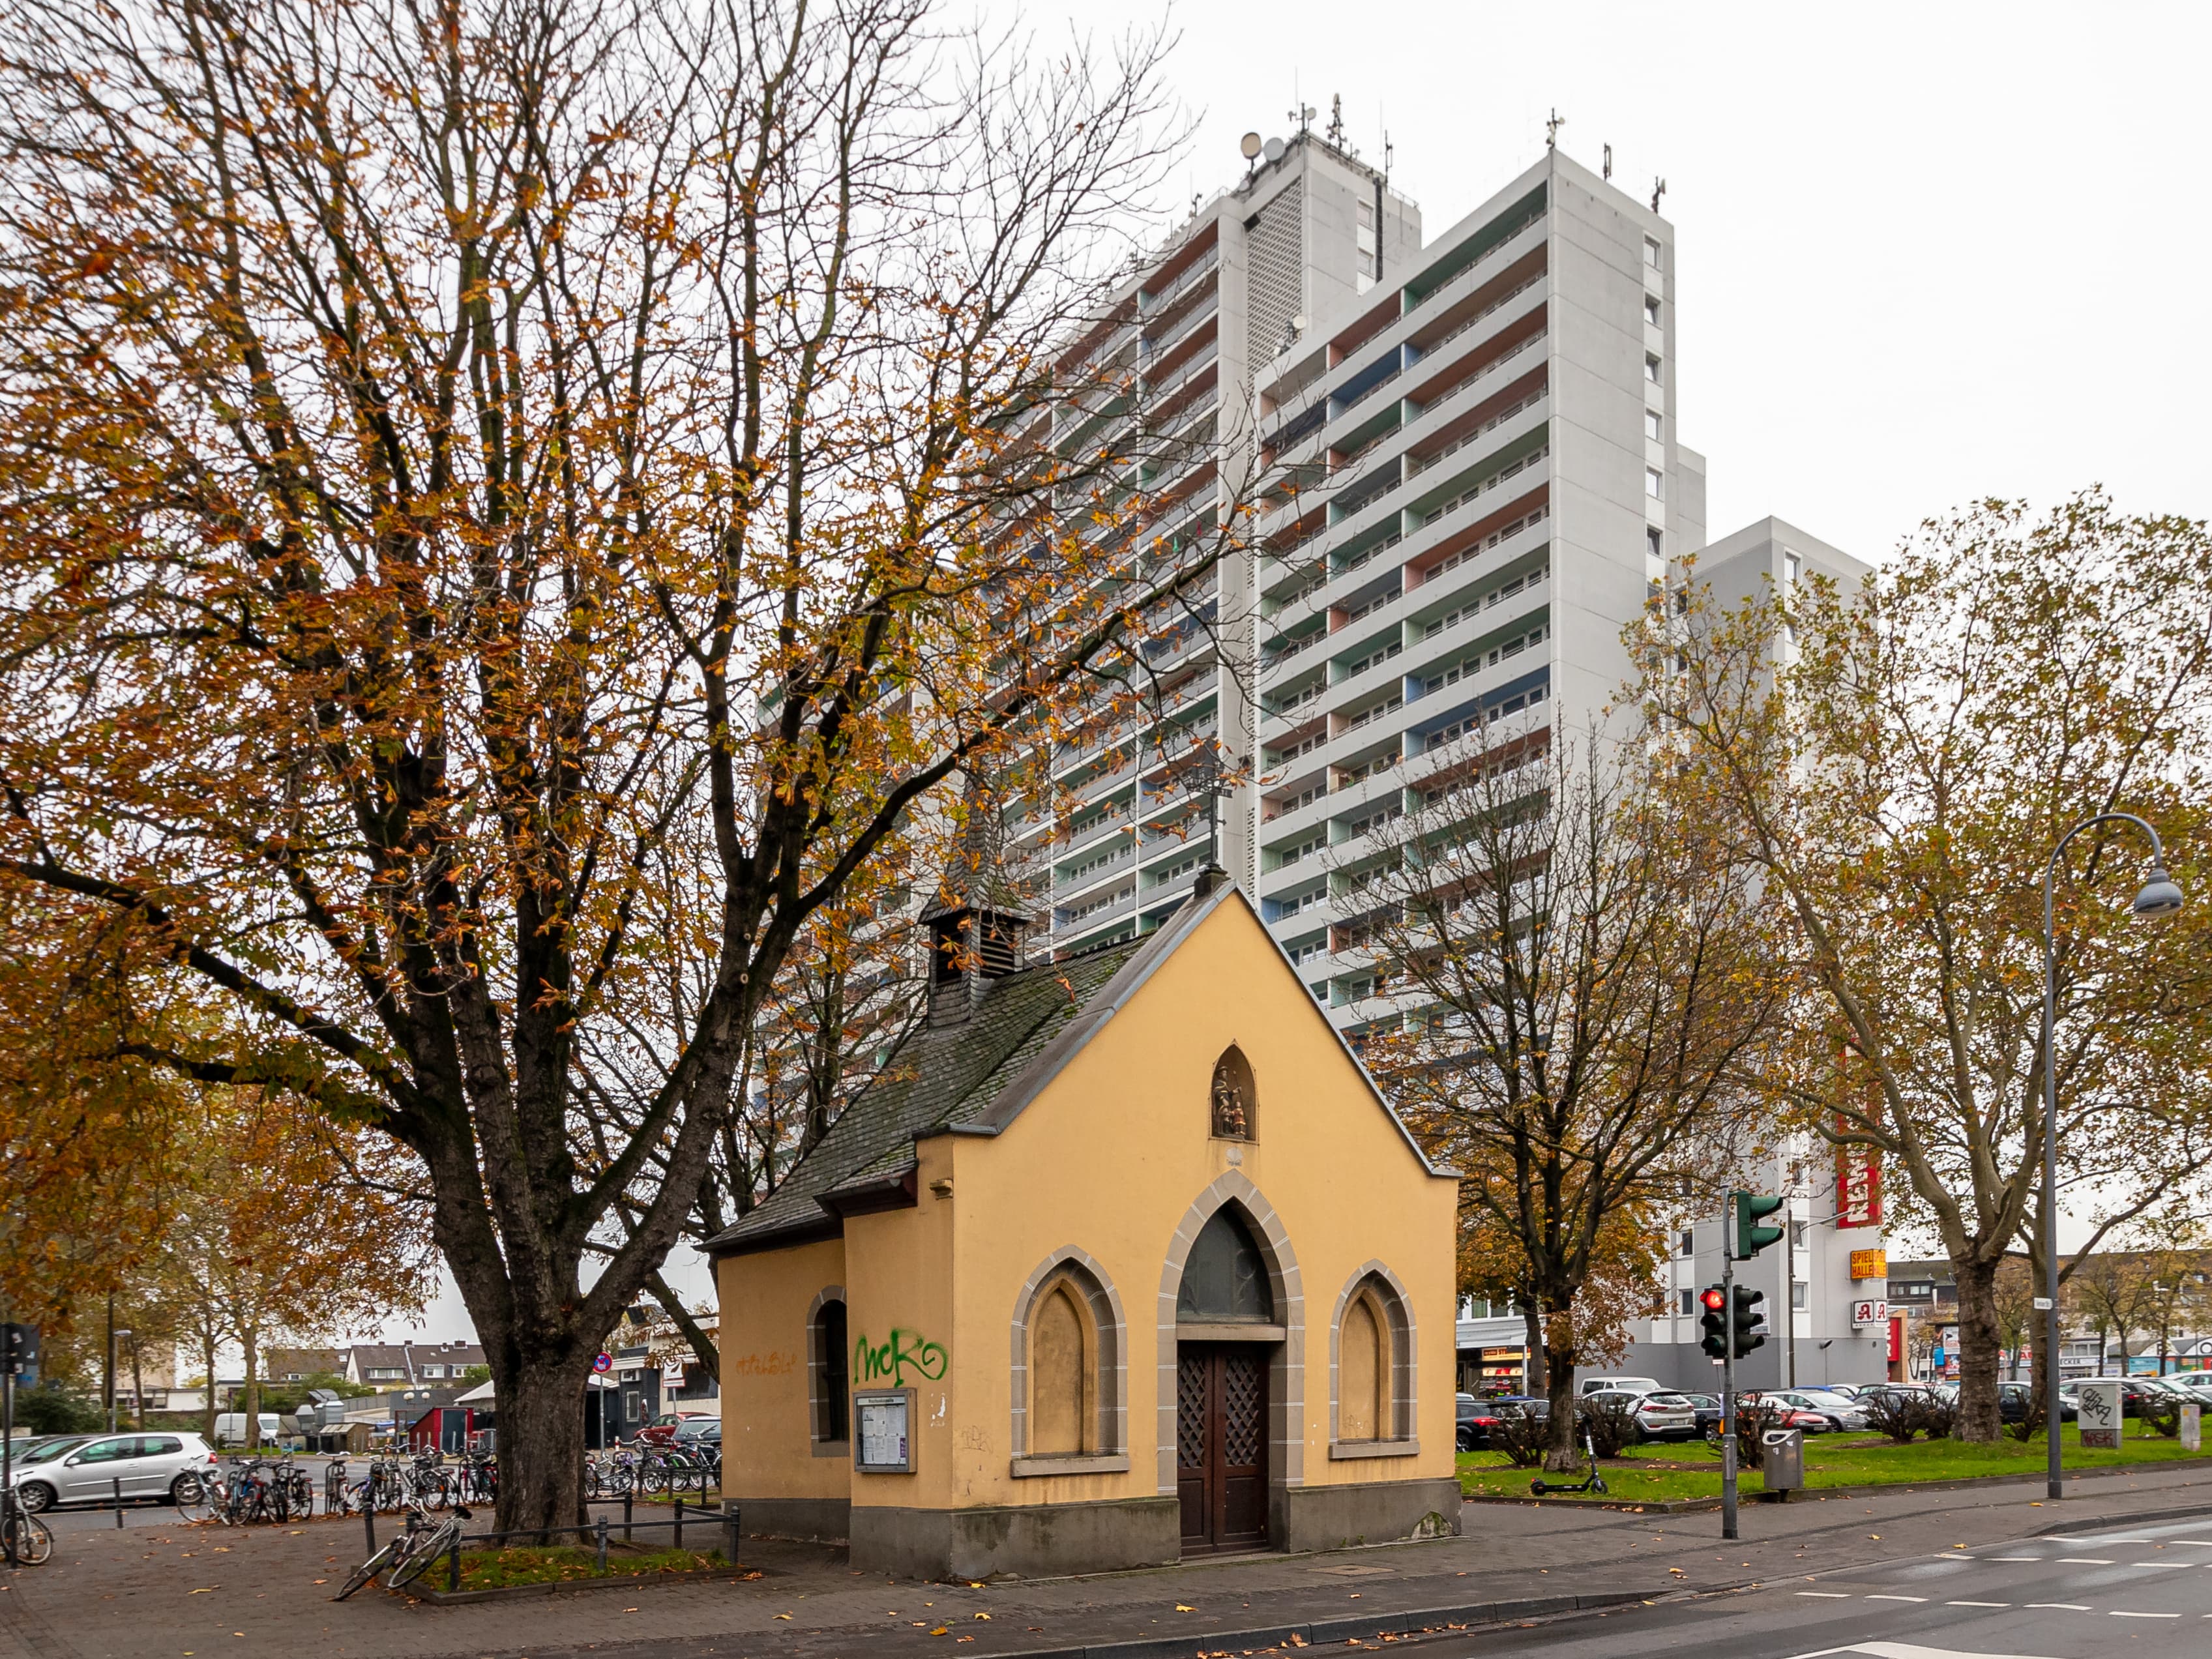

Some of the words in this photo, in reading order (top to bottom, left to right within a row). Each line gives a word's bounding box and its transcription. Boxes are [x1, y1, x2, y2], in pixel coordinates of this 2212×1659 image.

[1846, 1141, 1869, 1223] REWE
[1852, 1251, 1873, 1264] SPIEL
[1852, 1265, 1873, 1277] HALLE
